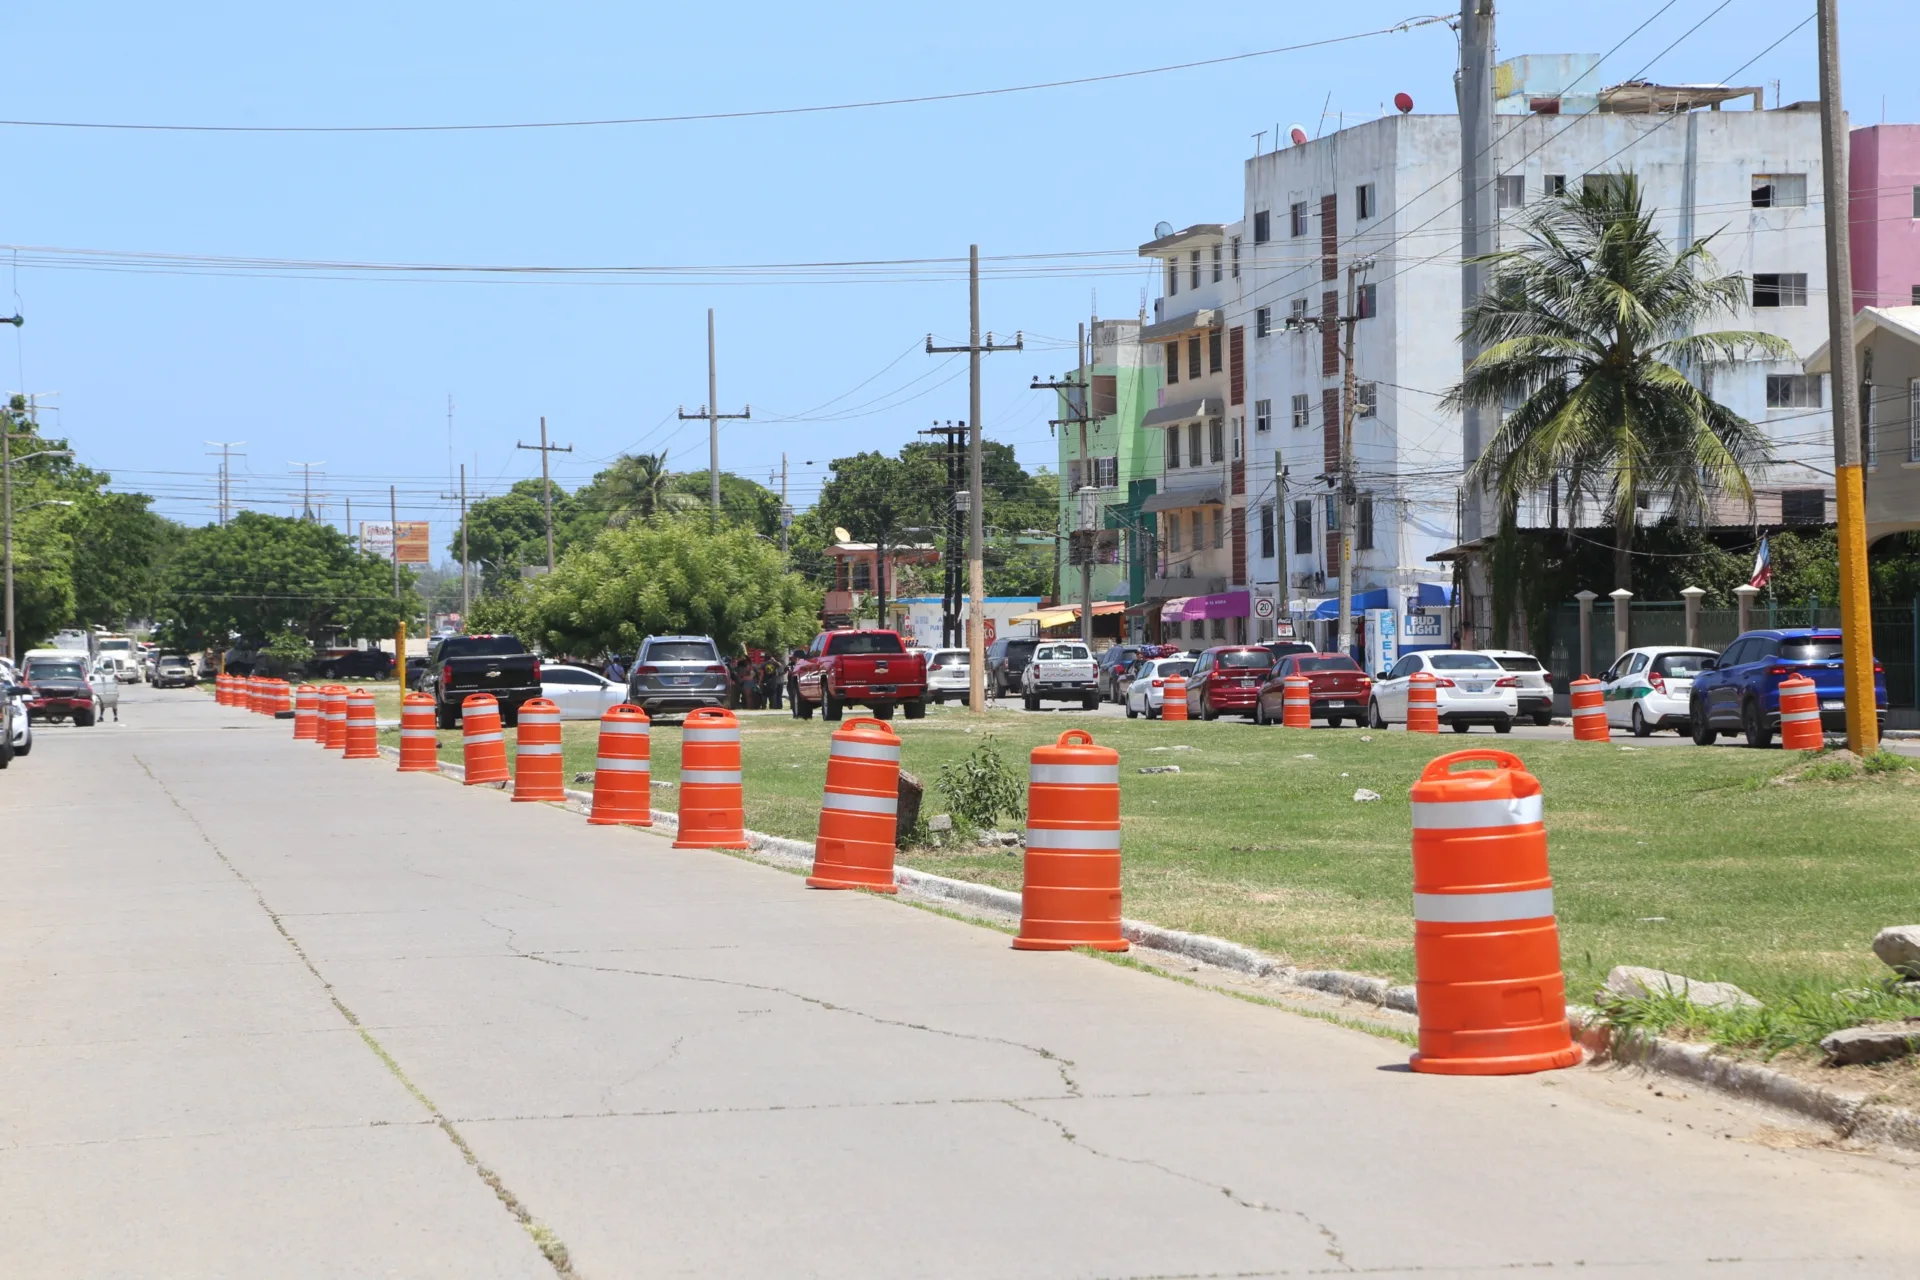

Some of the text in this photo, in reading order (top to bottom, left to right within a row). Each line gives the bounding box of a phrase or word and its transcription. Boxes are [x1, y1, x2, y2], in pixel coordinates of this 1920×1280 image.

[1260, 603, 1269, 611] 20
[1411, 616, 1435, 625] BUD
[1406, 625, 1439, 634] LIGHT
